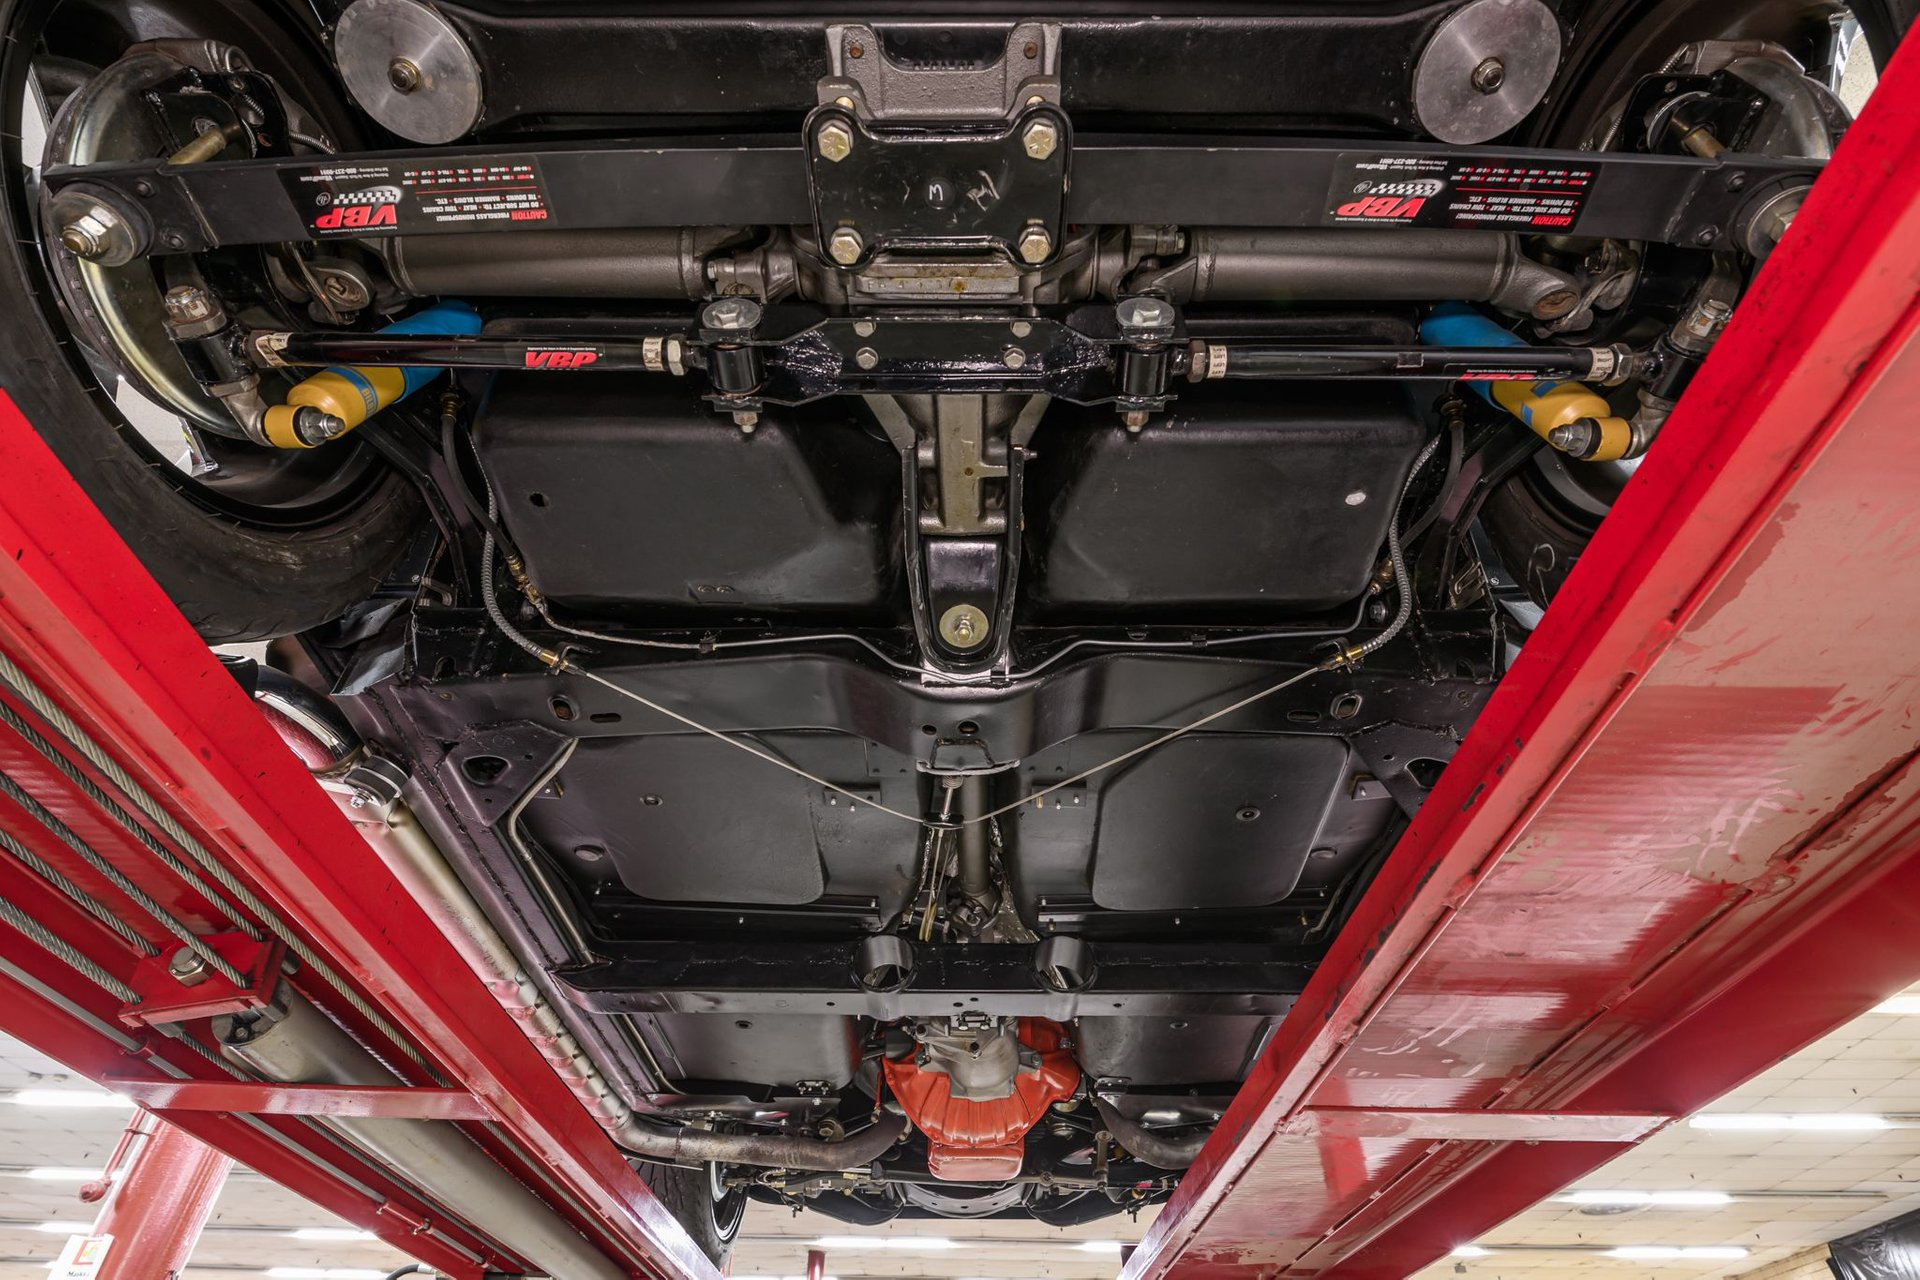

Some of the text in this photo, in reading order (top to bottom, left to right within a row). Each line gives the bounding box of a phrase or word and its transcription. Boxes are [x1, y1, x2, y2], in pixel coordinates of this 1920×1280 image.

[511, 210, 547, 220] CAUTION
[1336, 196, 1426, 218] VBP
[315, 205, 397, 228] VBP
[1531, 215, 1572, 225] CAUTION
[525, 352, 597, 368] VBP
